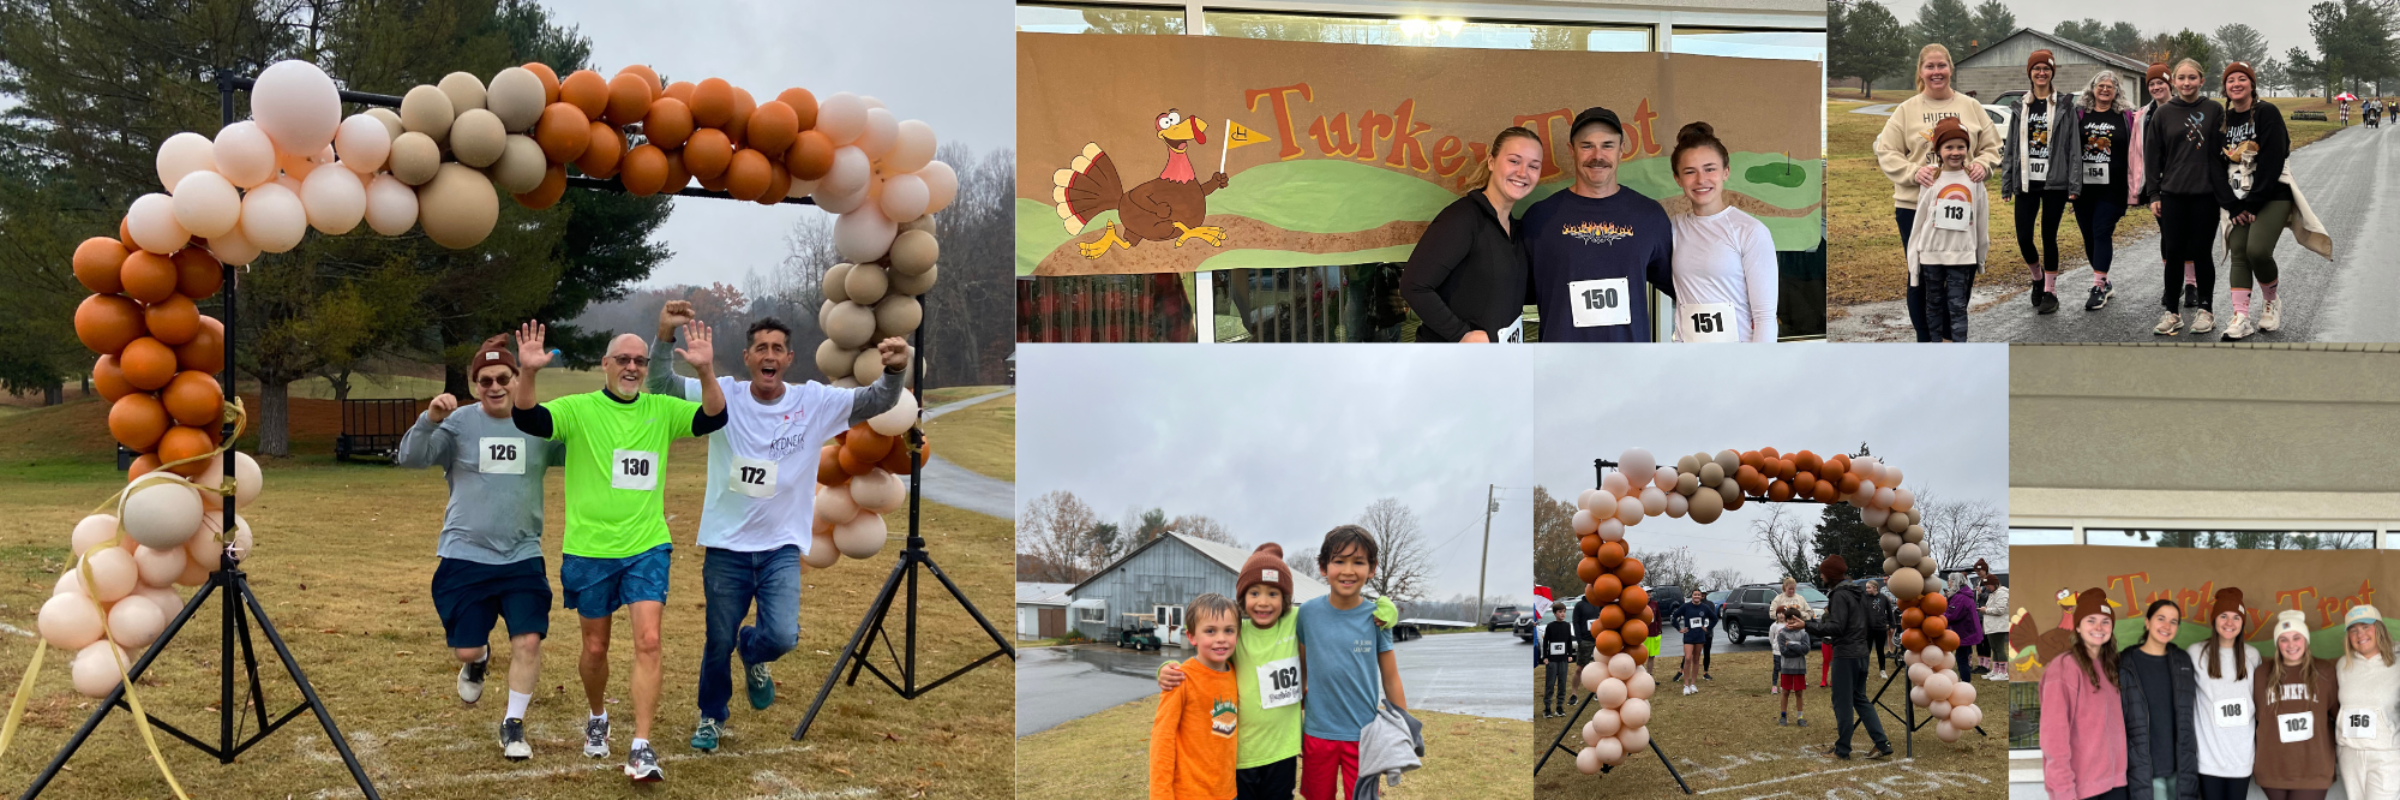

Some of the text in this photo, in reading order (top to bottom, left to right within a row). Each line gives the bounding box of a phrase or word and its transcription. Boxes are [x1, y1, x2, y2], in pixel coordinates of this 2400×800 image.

[1513, 97, 1662, 181] Tot
[2030, 163, 2045, 173] 107
[2088, 167, 2104, 177] 154
[1944, 205, 1964, 220] 113
[1581, 288, 1619, 310] 150
[1691, 312, 1724, 333] 151
[488, 444, 517, 461] 126
[621, 458, 650, 476] 130
[740, 466, 767, 485] 172
[2106, 571, 2275, 641] Turky
[1269, 666, 1299, 690] 162
[2220, 703, 2242, 717] 108
[2285, 717, 2308, 732] 102
[2349, 714, 2370, 728] 156
